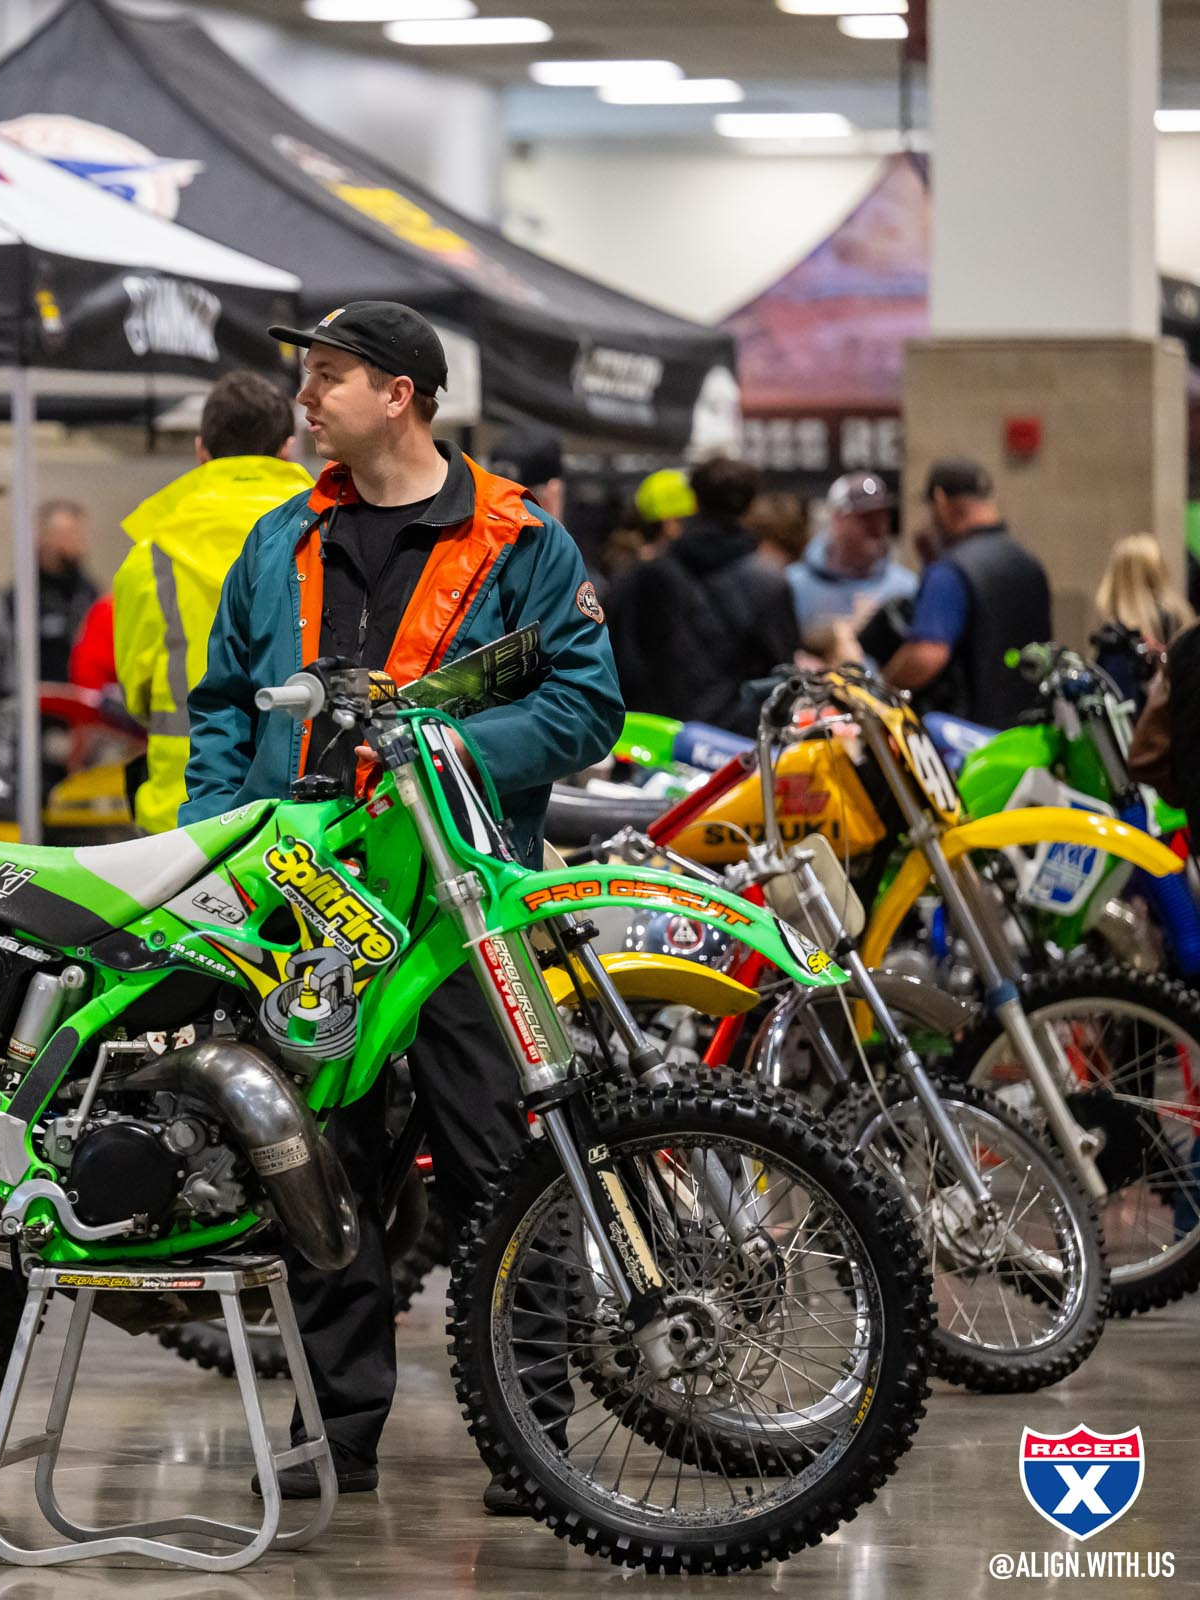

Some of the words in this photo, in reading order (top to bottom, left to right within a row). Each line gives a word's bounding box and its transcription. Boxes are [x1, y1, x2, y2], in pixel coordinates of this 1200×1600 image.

[268, 842, 393, 961] SplitFire
[282, 886, 321, 923] SPARK
[314, 918, 353, 954] PLUGS
[523, 880, 601, 913] PRO
[609, 879, 754, 926] CIRCUIT
[16, 944, 52, 963] Air
[493, 939, 521, 981] PRO
[511, 981, 552, 1053] CIRCUIT
[512, 1008, 533, 1046] WORKS
